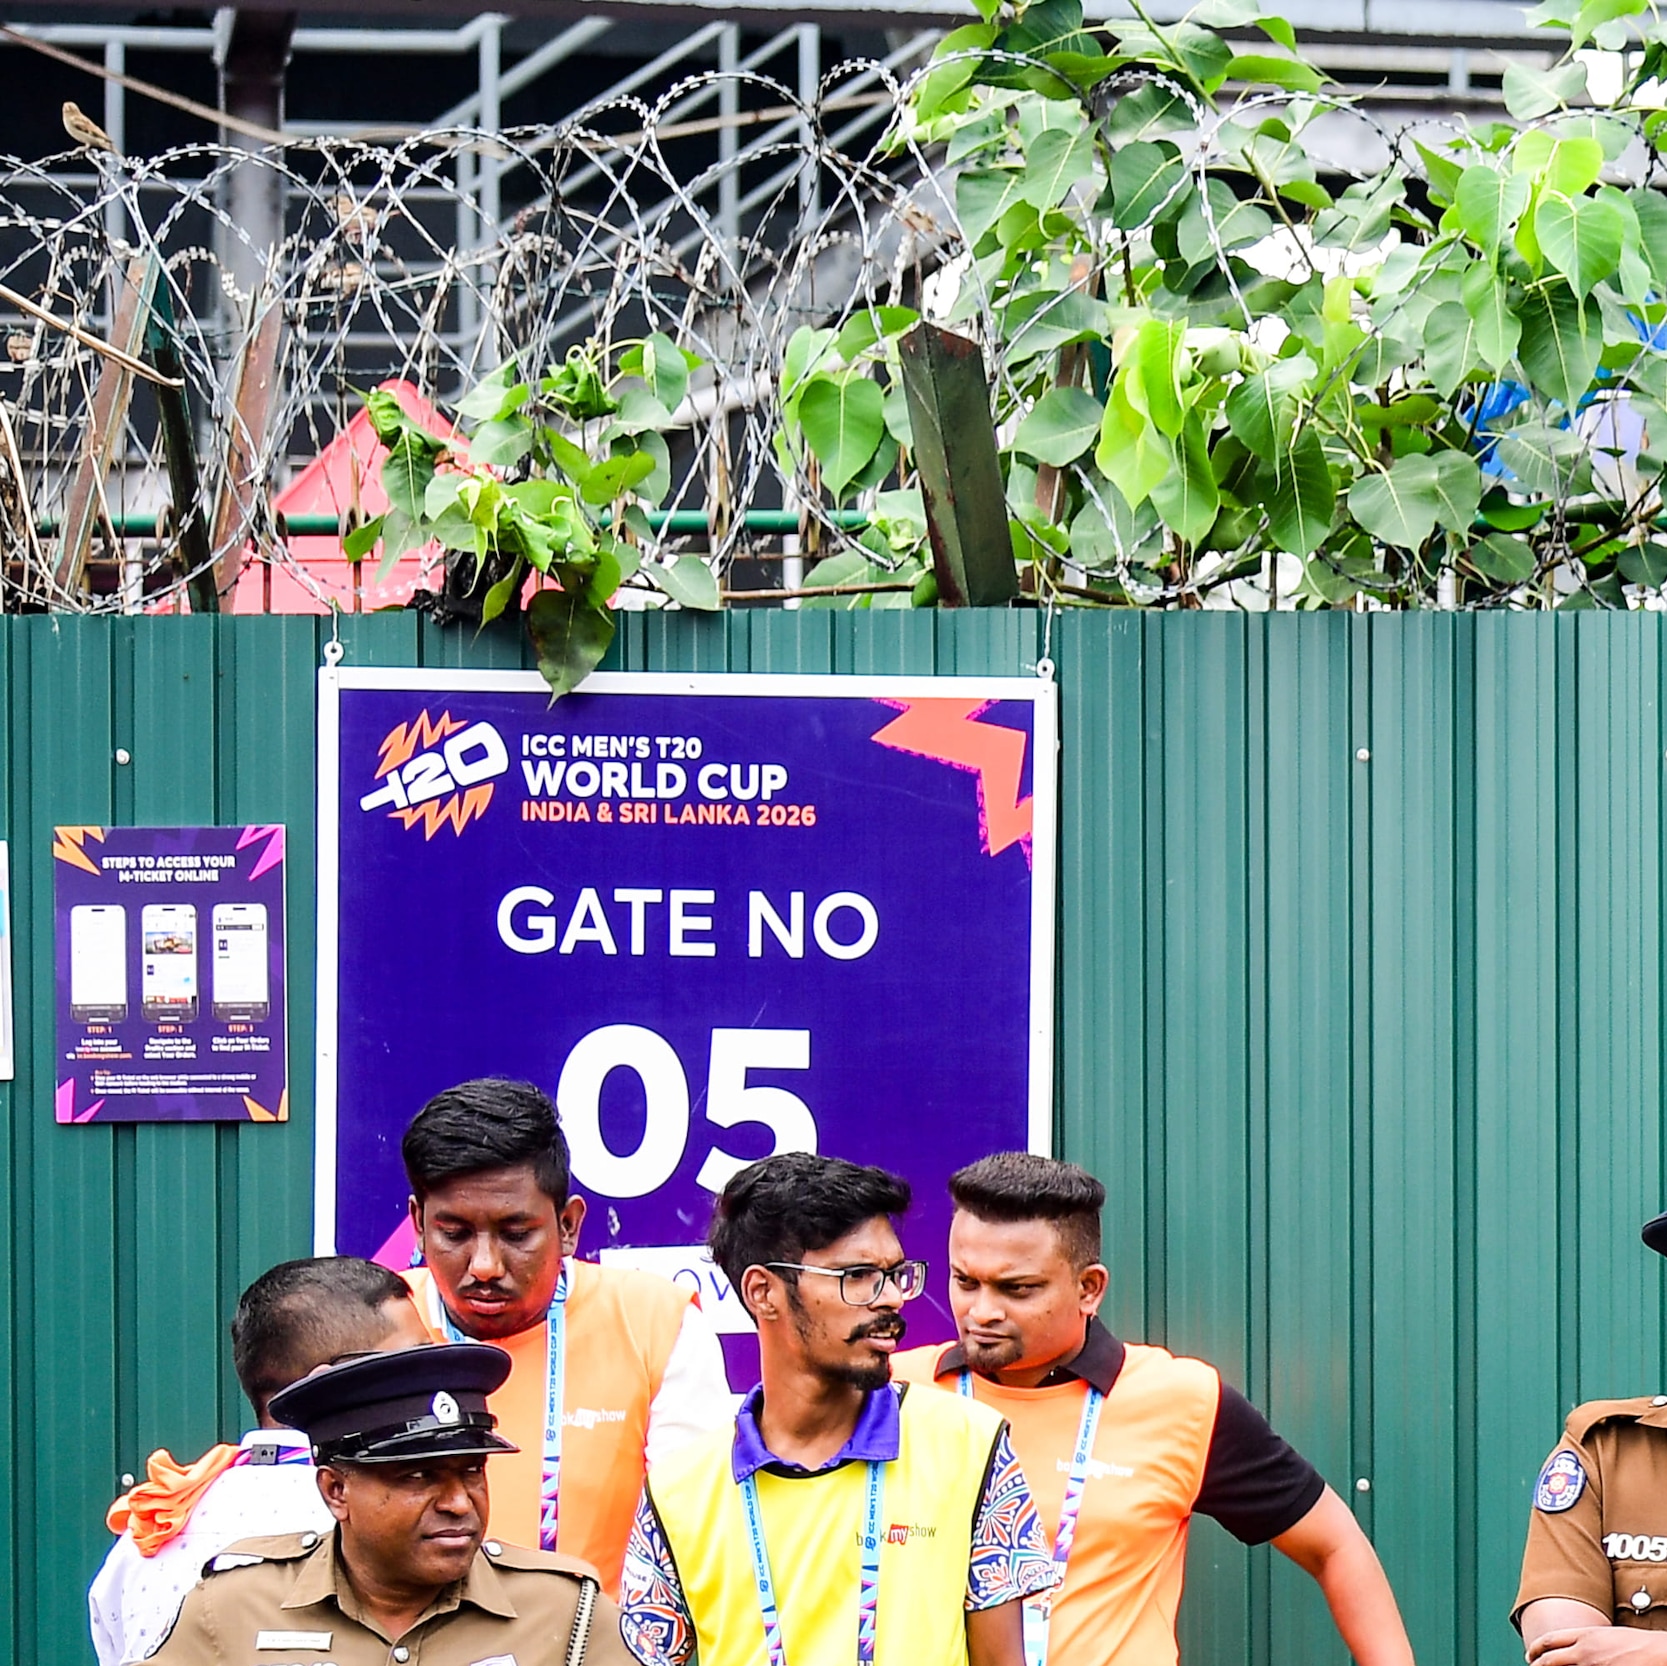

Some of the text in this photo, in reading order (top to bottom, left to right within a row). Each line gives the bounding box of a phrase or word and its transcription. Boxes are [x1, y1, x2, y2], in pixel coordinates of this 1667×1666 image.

[521, 733, 703, 760] ICC MEN'S T20
[520, 760, 789, 800] WORLD CUP
[521, 801, 817, 827] INDIA & SRI LANKA 2026
[102, 856, 236, 869] STEPS TO ACCESS YOUR
[118, 869, 219, 882] M-TICKET ONLINE
[498, 887, 878, 959] GATE NO
[556, 1023, 819, 1198] 05
[747, 1501, 756, 1526] WORLD
[856, 1522, 937, 1547] bkmyshow
